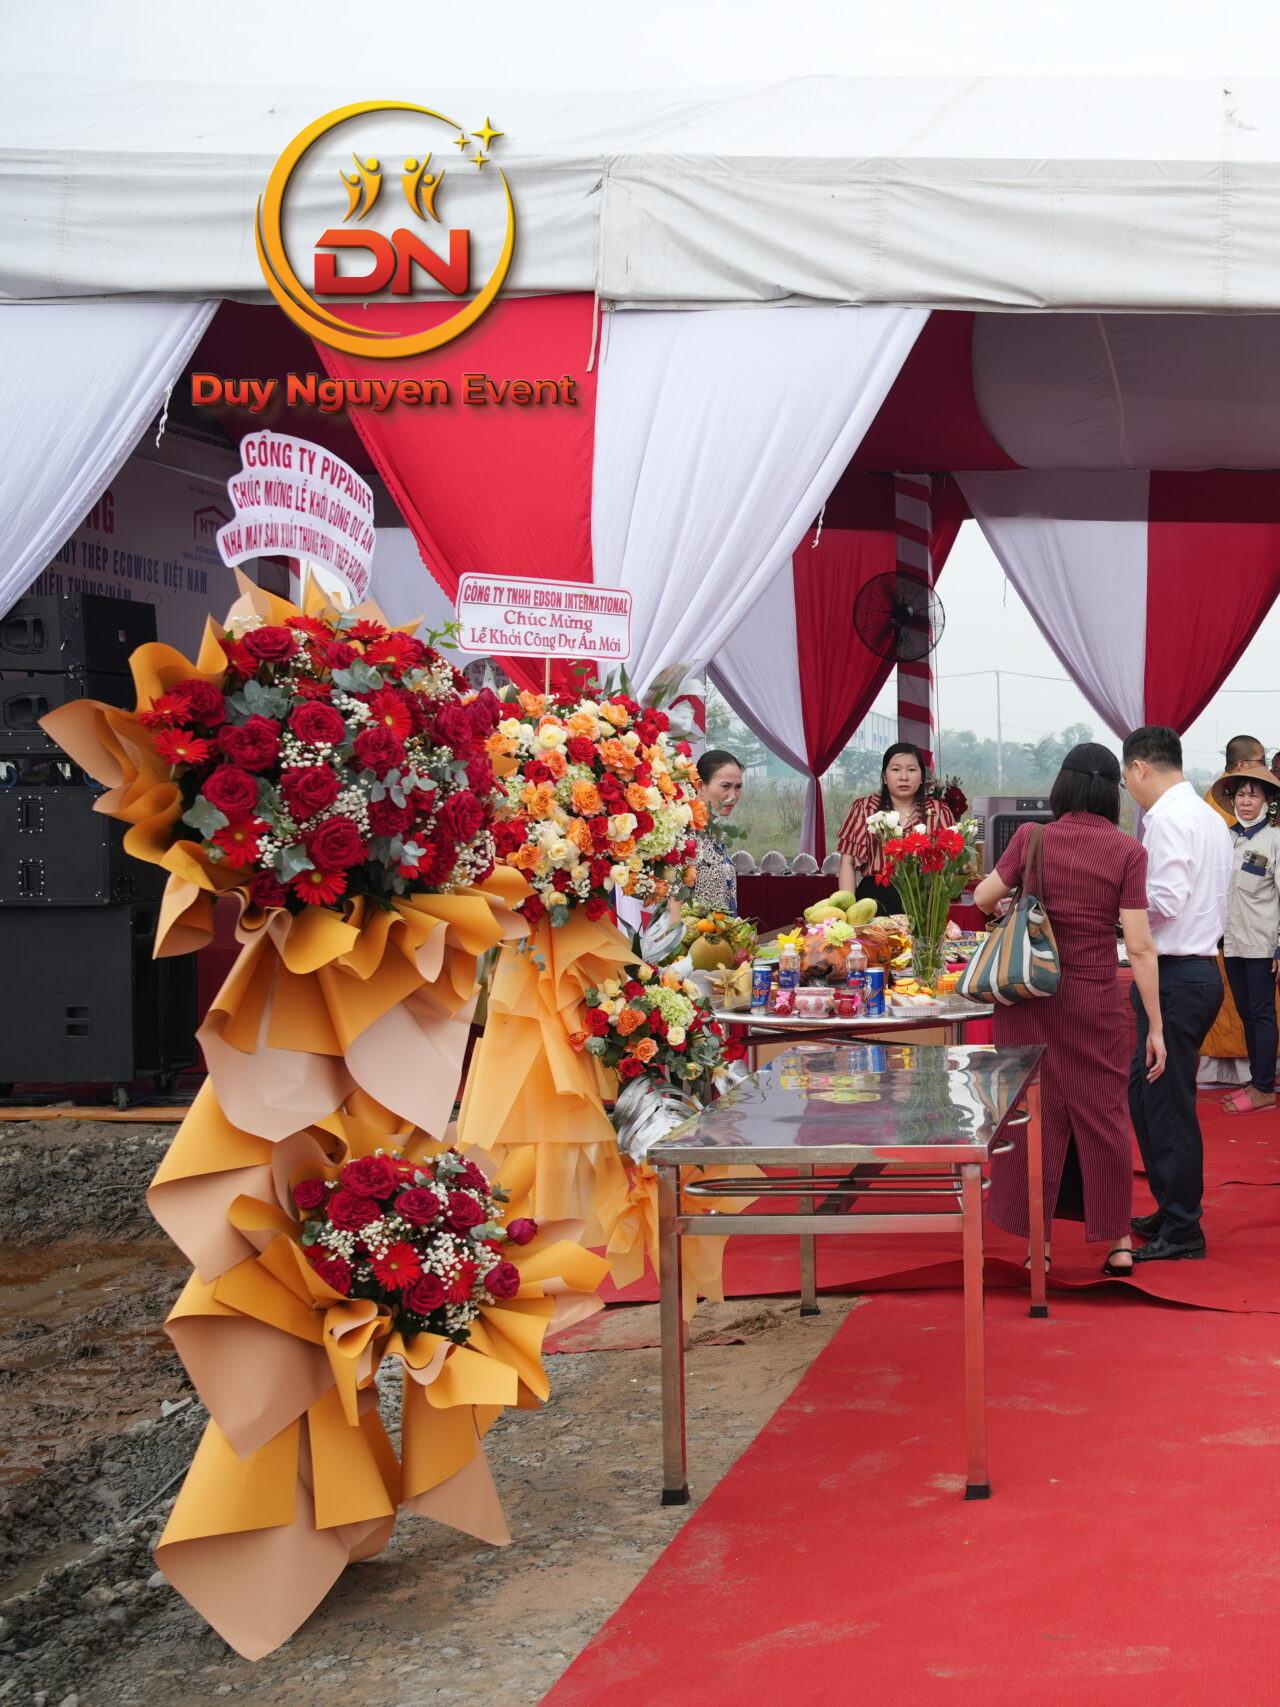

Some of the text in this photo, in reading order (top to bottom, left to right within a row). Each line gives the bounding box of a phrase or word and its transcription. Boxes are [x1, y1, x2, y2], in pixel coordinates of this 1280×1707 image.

[244, 434, 373, 515] CÔNG TY PVPAINT
[86, 488, 114, 535] NG
[232, 474, 261, 510] CHÚC
[264, 475, 293, 509] MỪNG
[294, 478, 308, 513] LỄ
[328, 498, 351, 534] CÔNG
[222, 523, 244, 559] NHÀ
[244, 517, 263, 551] MÁY
[55, 539, 77, 567] HUY
[82, 539, 109, 573] THÉP
[113, 549, 159, 586] ECOWISE
[163, 558, 184, 595] VIỆT
[187, 568, 208, 596] NAM
[463, 580, 629, 615] CÔNG TY TNHH EDSON INTERNATIONAL
[470, 626, 621, 653] Lễ Khởi Công Dự Án Mới
[503, 609, 594, 634] Chúc Mừng
